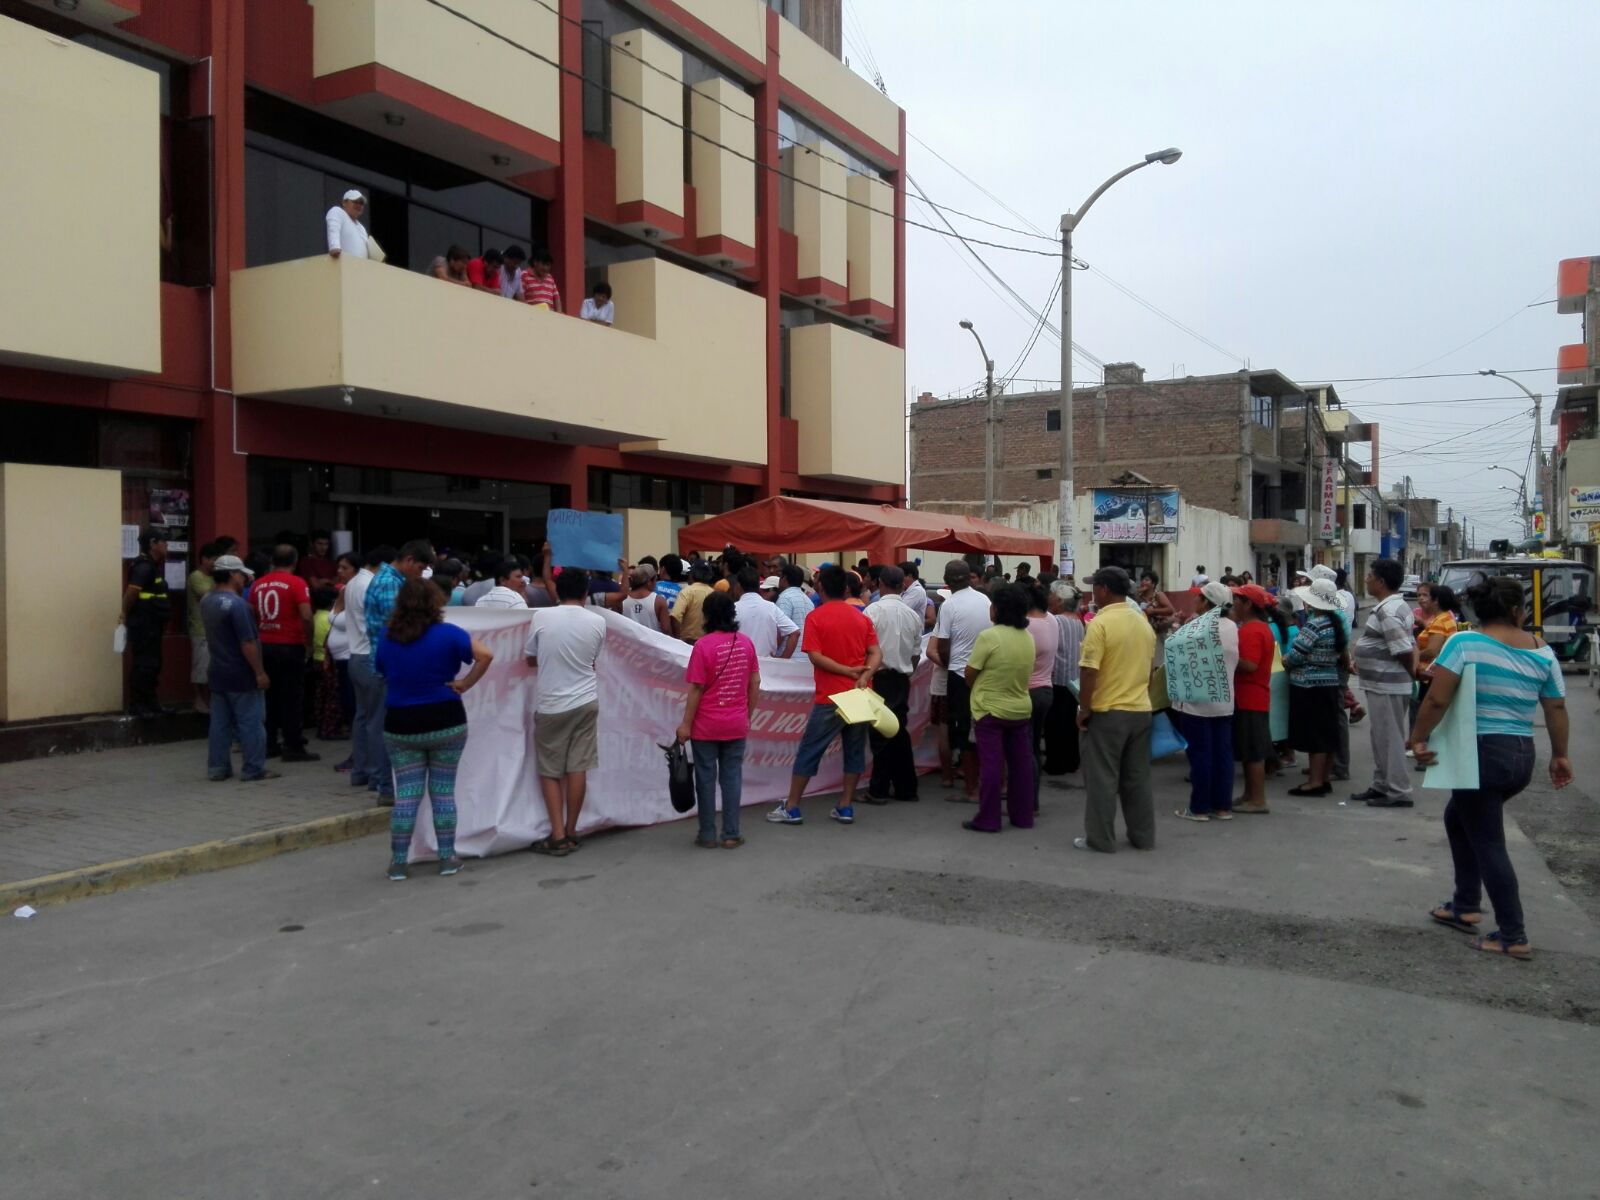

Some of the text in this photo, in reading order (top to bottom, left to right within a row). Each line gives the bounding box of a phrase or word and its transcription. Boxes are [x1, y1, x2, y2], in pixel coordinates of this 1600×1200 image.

[1127, 507, 1146, 520] LA
[1323, 468, 1333, 530] FARMACIA
[258, 590, 279, 620] 10
[1202, 670, 1220, 703] MOCHE
